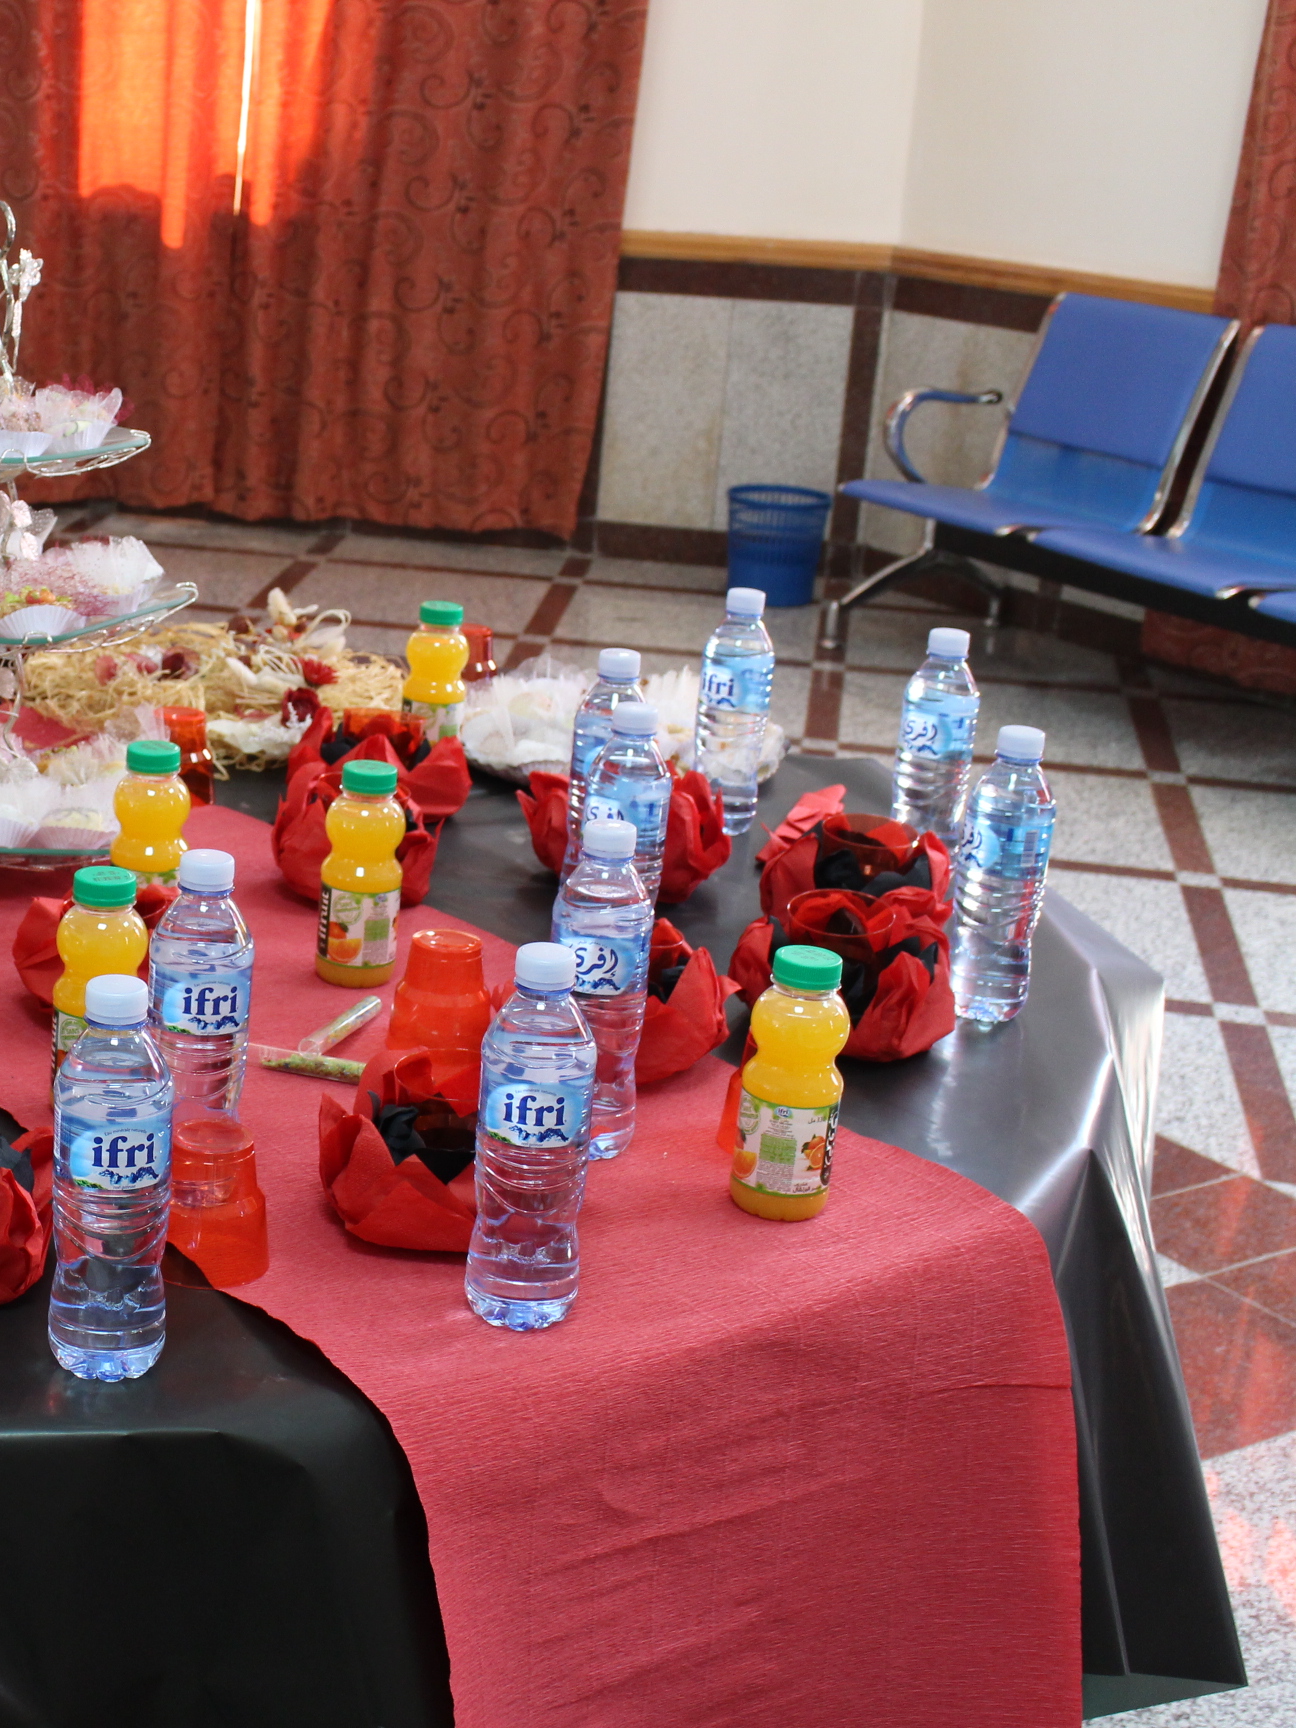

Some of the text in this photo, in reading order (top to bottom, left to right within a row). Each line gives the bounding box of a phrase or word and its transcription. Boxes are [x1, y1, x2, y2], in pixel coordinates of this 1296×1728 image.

[182, 986, 238, 1016] ifri
[503, 1093, 565, 1127] ifri
[92, 1133, 155, 1168] ifri
